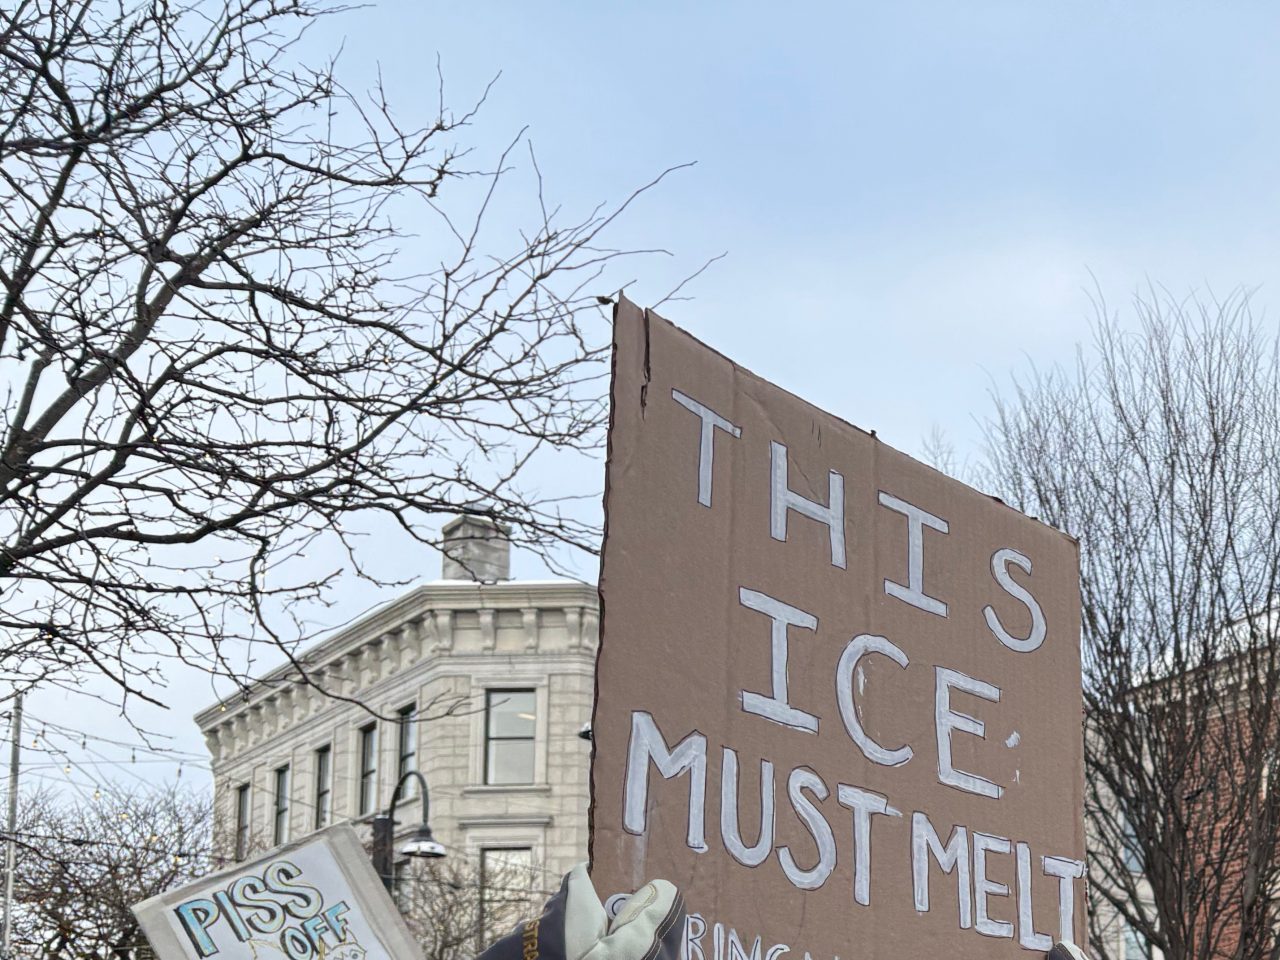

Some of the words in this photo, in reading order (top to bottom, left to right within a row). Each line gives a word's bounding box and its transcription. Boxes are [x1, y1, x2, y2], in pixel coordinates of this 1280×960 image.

[671, 388, 1047, 653] THIS
[739, 586, 1004, 800] ICE
[174, 860, 324, 960] PISS
[623, 710, 902, 907] MUST
[911, 810, 1088, 952] MELT
